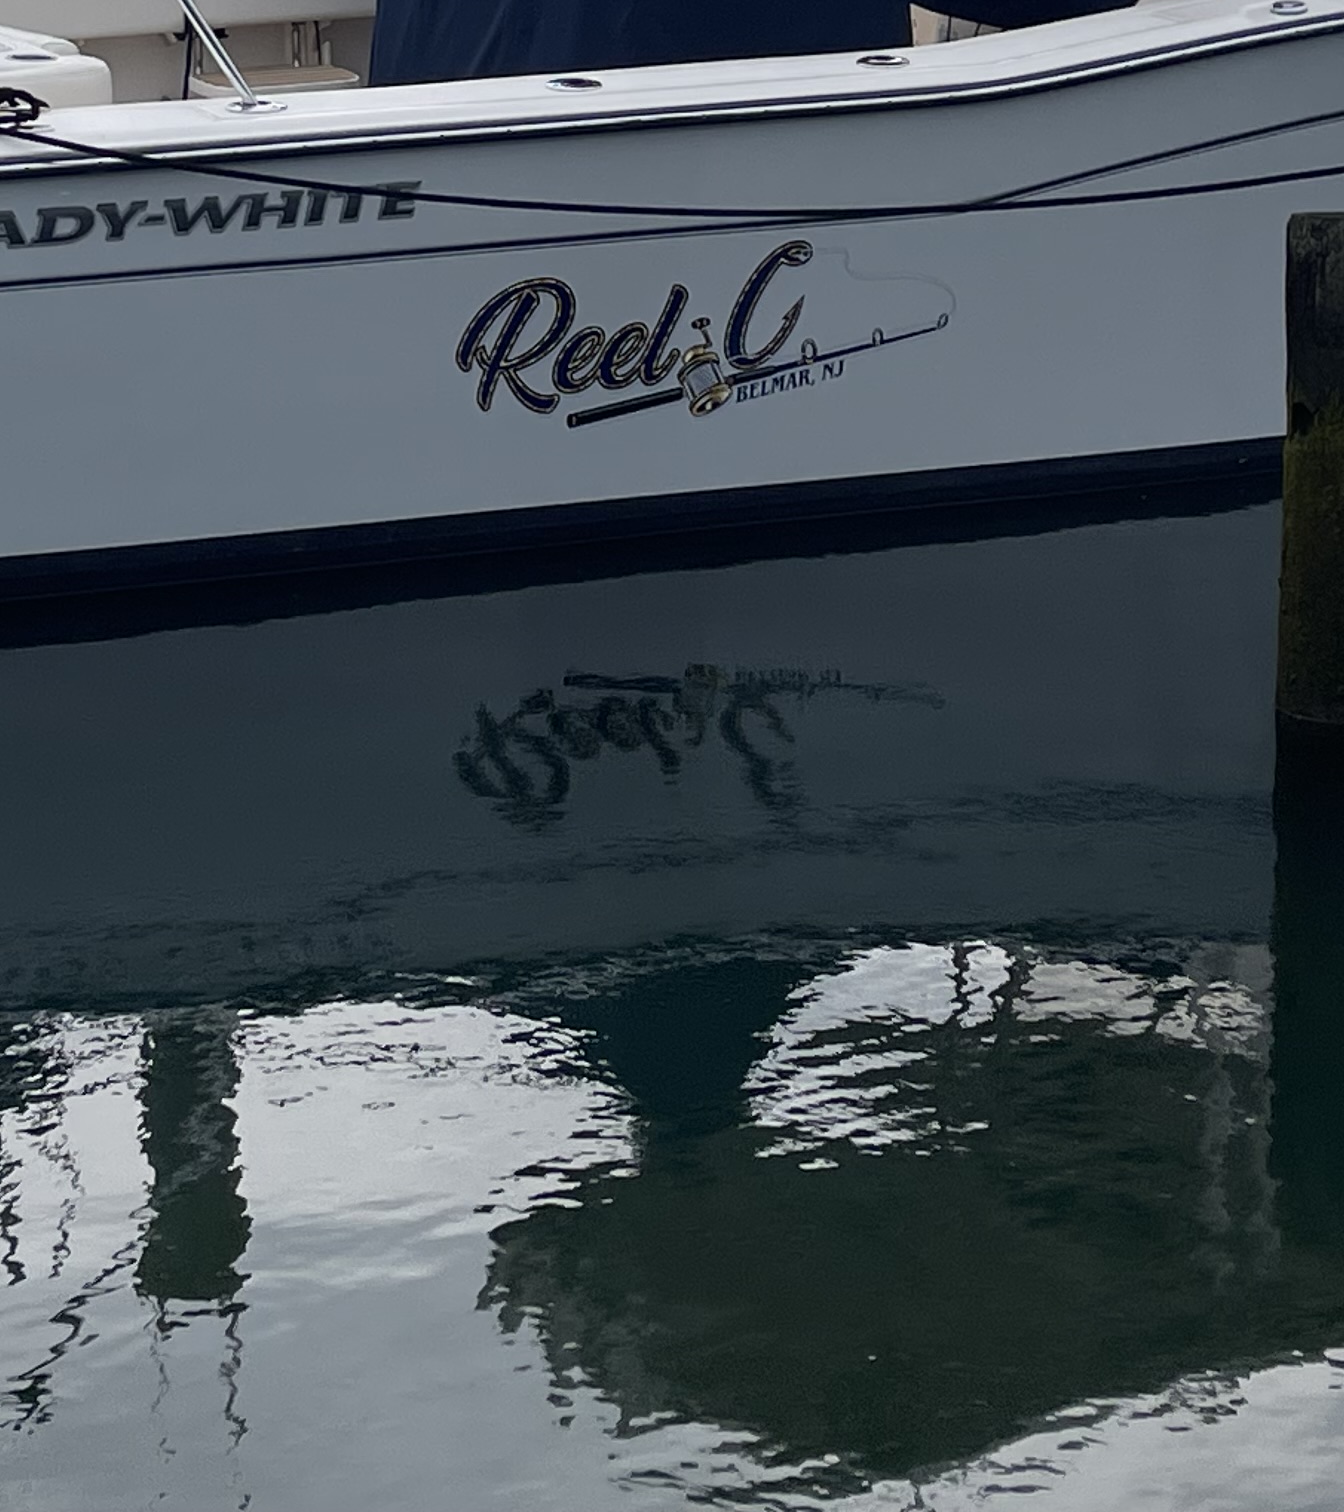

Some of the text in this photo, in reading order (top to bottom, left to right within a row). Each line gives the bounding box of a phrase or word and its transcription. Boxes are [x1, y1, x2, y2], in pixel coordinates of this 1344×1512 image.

[456, 276, 689, 414] Reel
[736, 360, 844, 403] BELMAR, NJ
